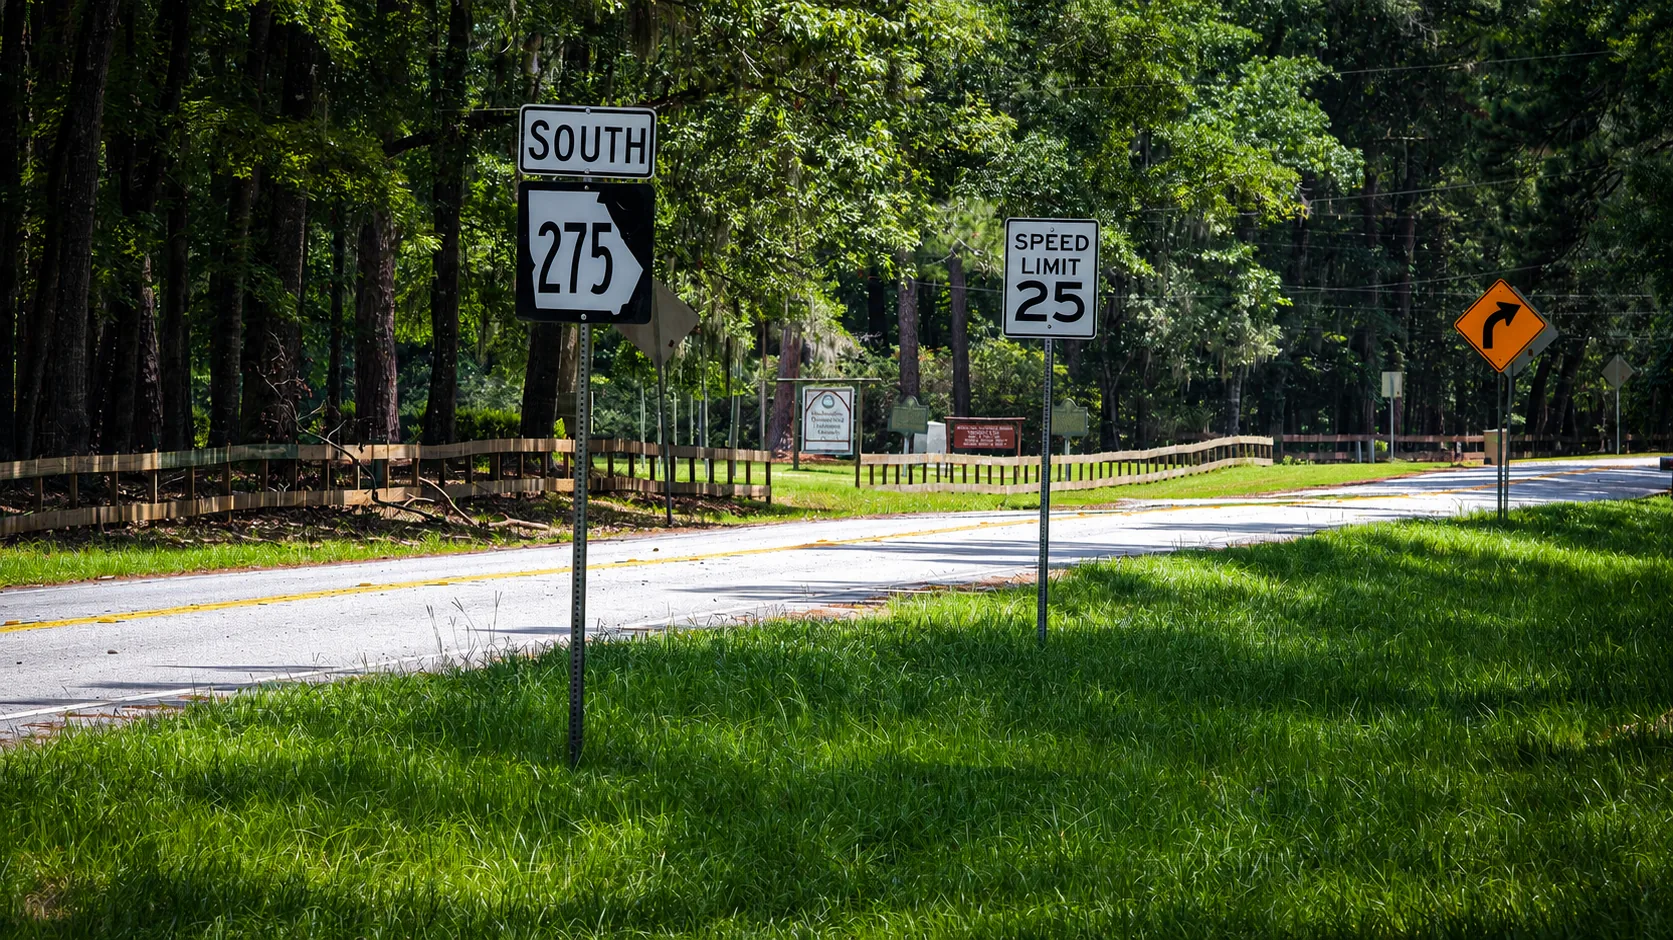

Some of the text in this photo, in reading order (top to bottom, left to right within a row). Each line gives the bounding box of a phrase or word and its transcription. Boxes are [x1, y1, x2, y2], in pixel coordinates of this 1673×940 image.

[528, 119, 647, 165] SOUTH
[537, 221, 614, 295] 275
[1014, 233, 1090, 252] SPEED
[1021, 257, 1081, 276] LIMIT
[1014, 280, 1085, 323] 25
